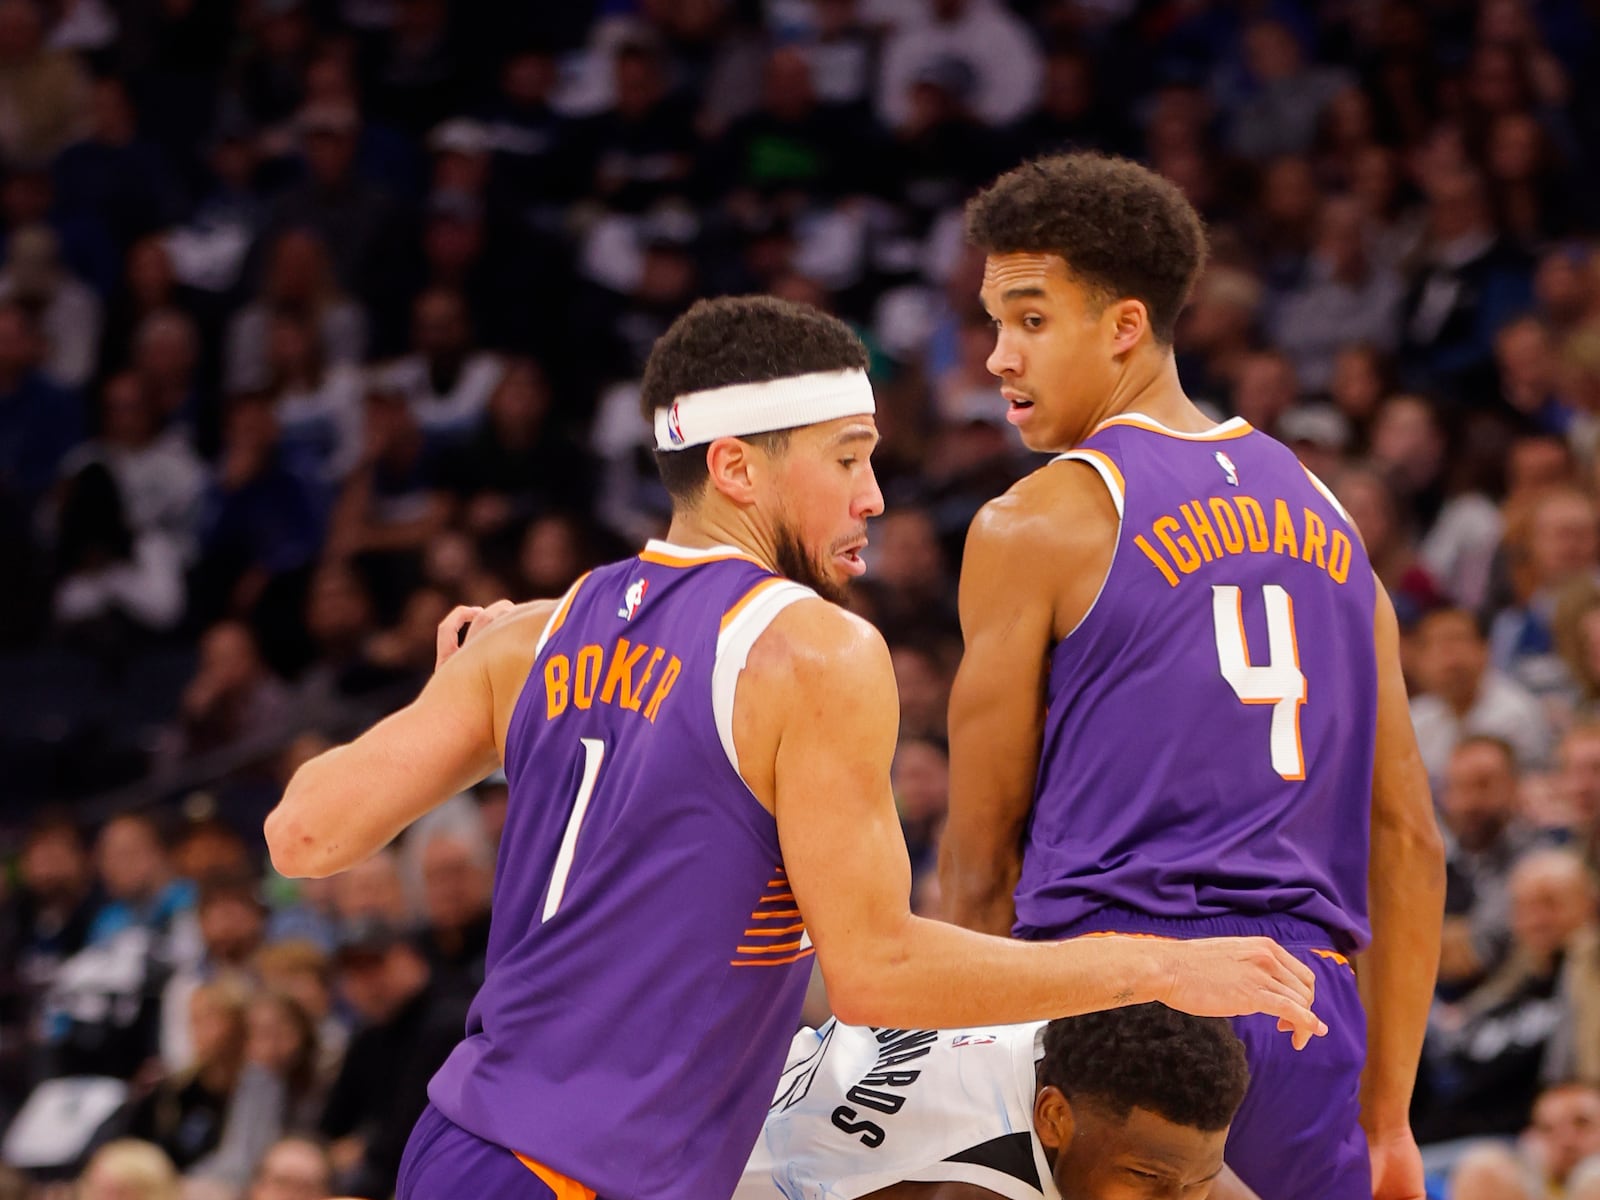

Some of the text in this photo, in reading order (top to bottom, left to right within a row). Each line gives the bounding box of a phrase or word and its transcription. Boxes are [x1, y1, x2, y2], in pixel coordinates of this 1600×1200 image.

[1134, 495, 1352, 587] IGHODARO
[1211, 584, 1307, 782] 4
[541, 738, 606, 924] 1
[831, 1028, 938, 1148] WARDS
